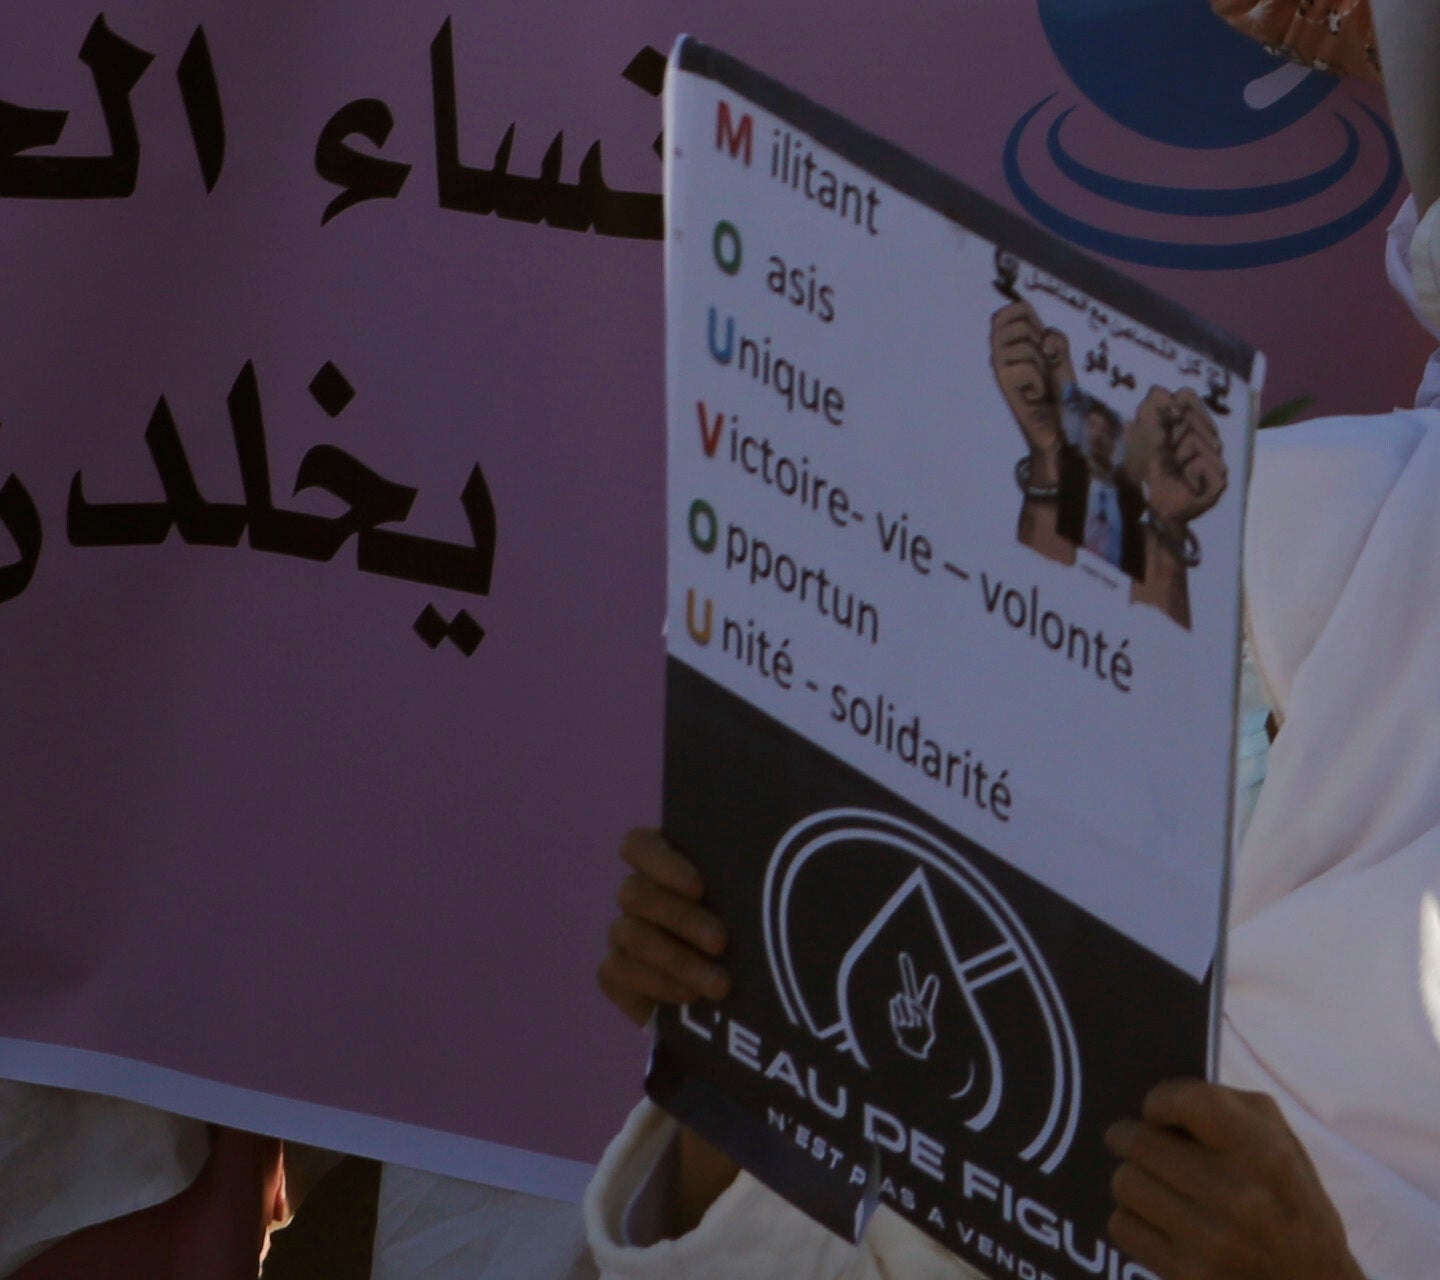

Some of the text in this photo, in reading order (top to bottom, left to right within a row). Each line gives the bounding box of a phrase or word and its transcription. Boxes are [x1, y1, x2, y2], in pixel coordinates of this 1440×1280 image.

[708, 305, 845, 426] Unique
[876, 511, 933, 575] vie
[979, 571, 1134, 694] volonté
[830, 683, 1013, 824] solidarité
[767, 1105, 844, 1171] N'EST
[958, 1220, 1059, 1280] VEND
[863, 1103, 945, 1182] DE
